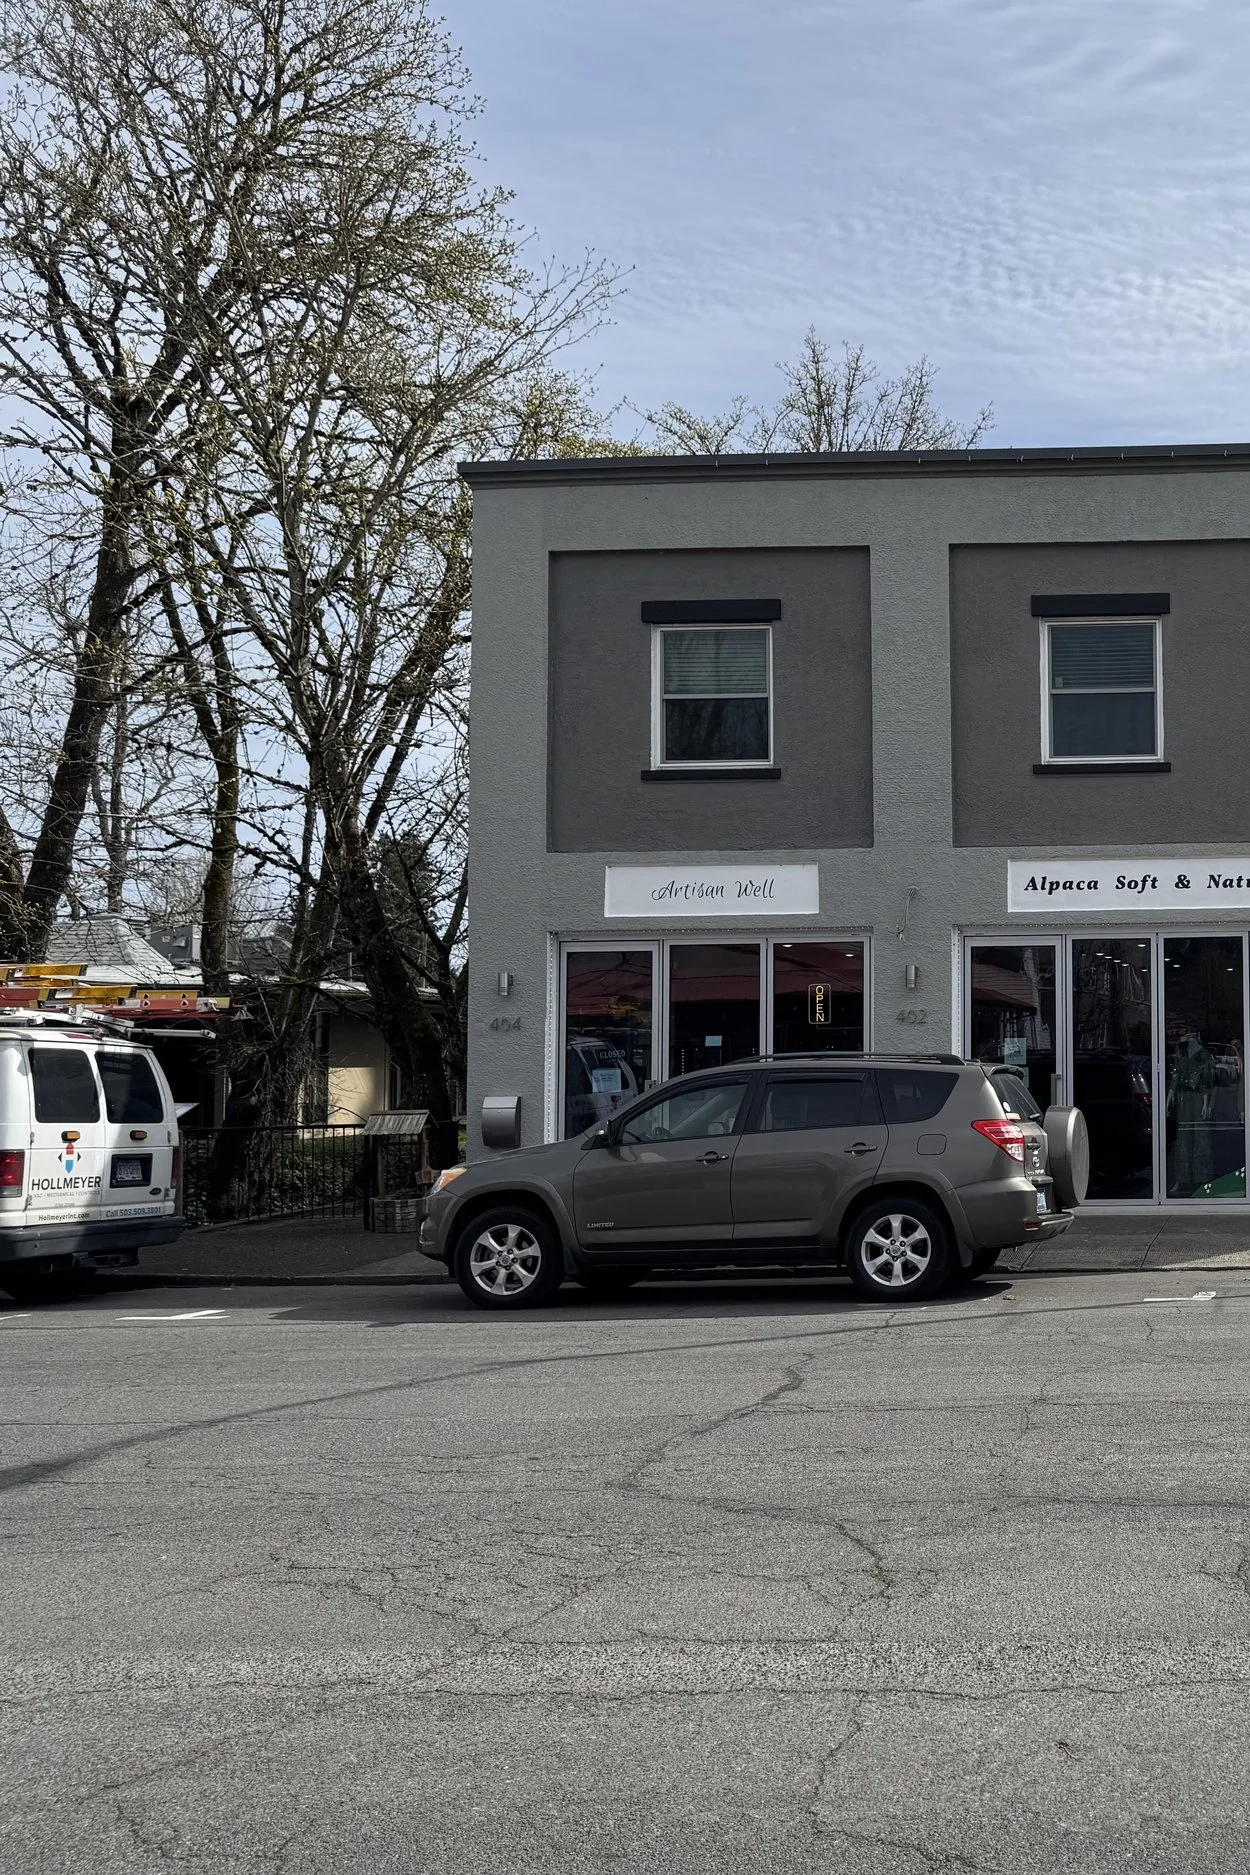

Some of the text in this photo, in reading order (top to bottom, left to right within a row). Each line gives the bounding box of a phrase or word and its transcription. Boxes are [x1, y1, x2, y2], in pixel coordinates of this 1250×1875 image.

[651, 878, 776, 901] Artisan Well
[1024, 876, 1100, 896] Alpaca
[1115, 874, 1159, 894] Soft
[1174, 874, 1192, 889] &
[815, 985, 825, 1022] OPEN
[489, 1016, 521, 1032] 404
[896, 1009, 928, 1024] 402
[599, 1049, 626, 1059] CLOSED
[31, 1176, 101, 1191] HOLLMEYER
[105, 1209, 119, 1218] Call
